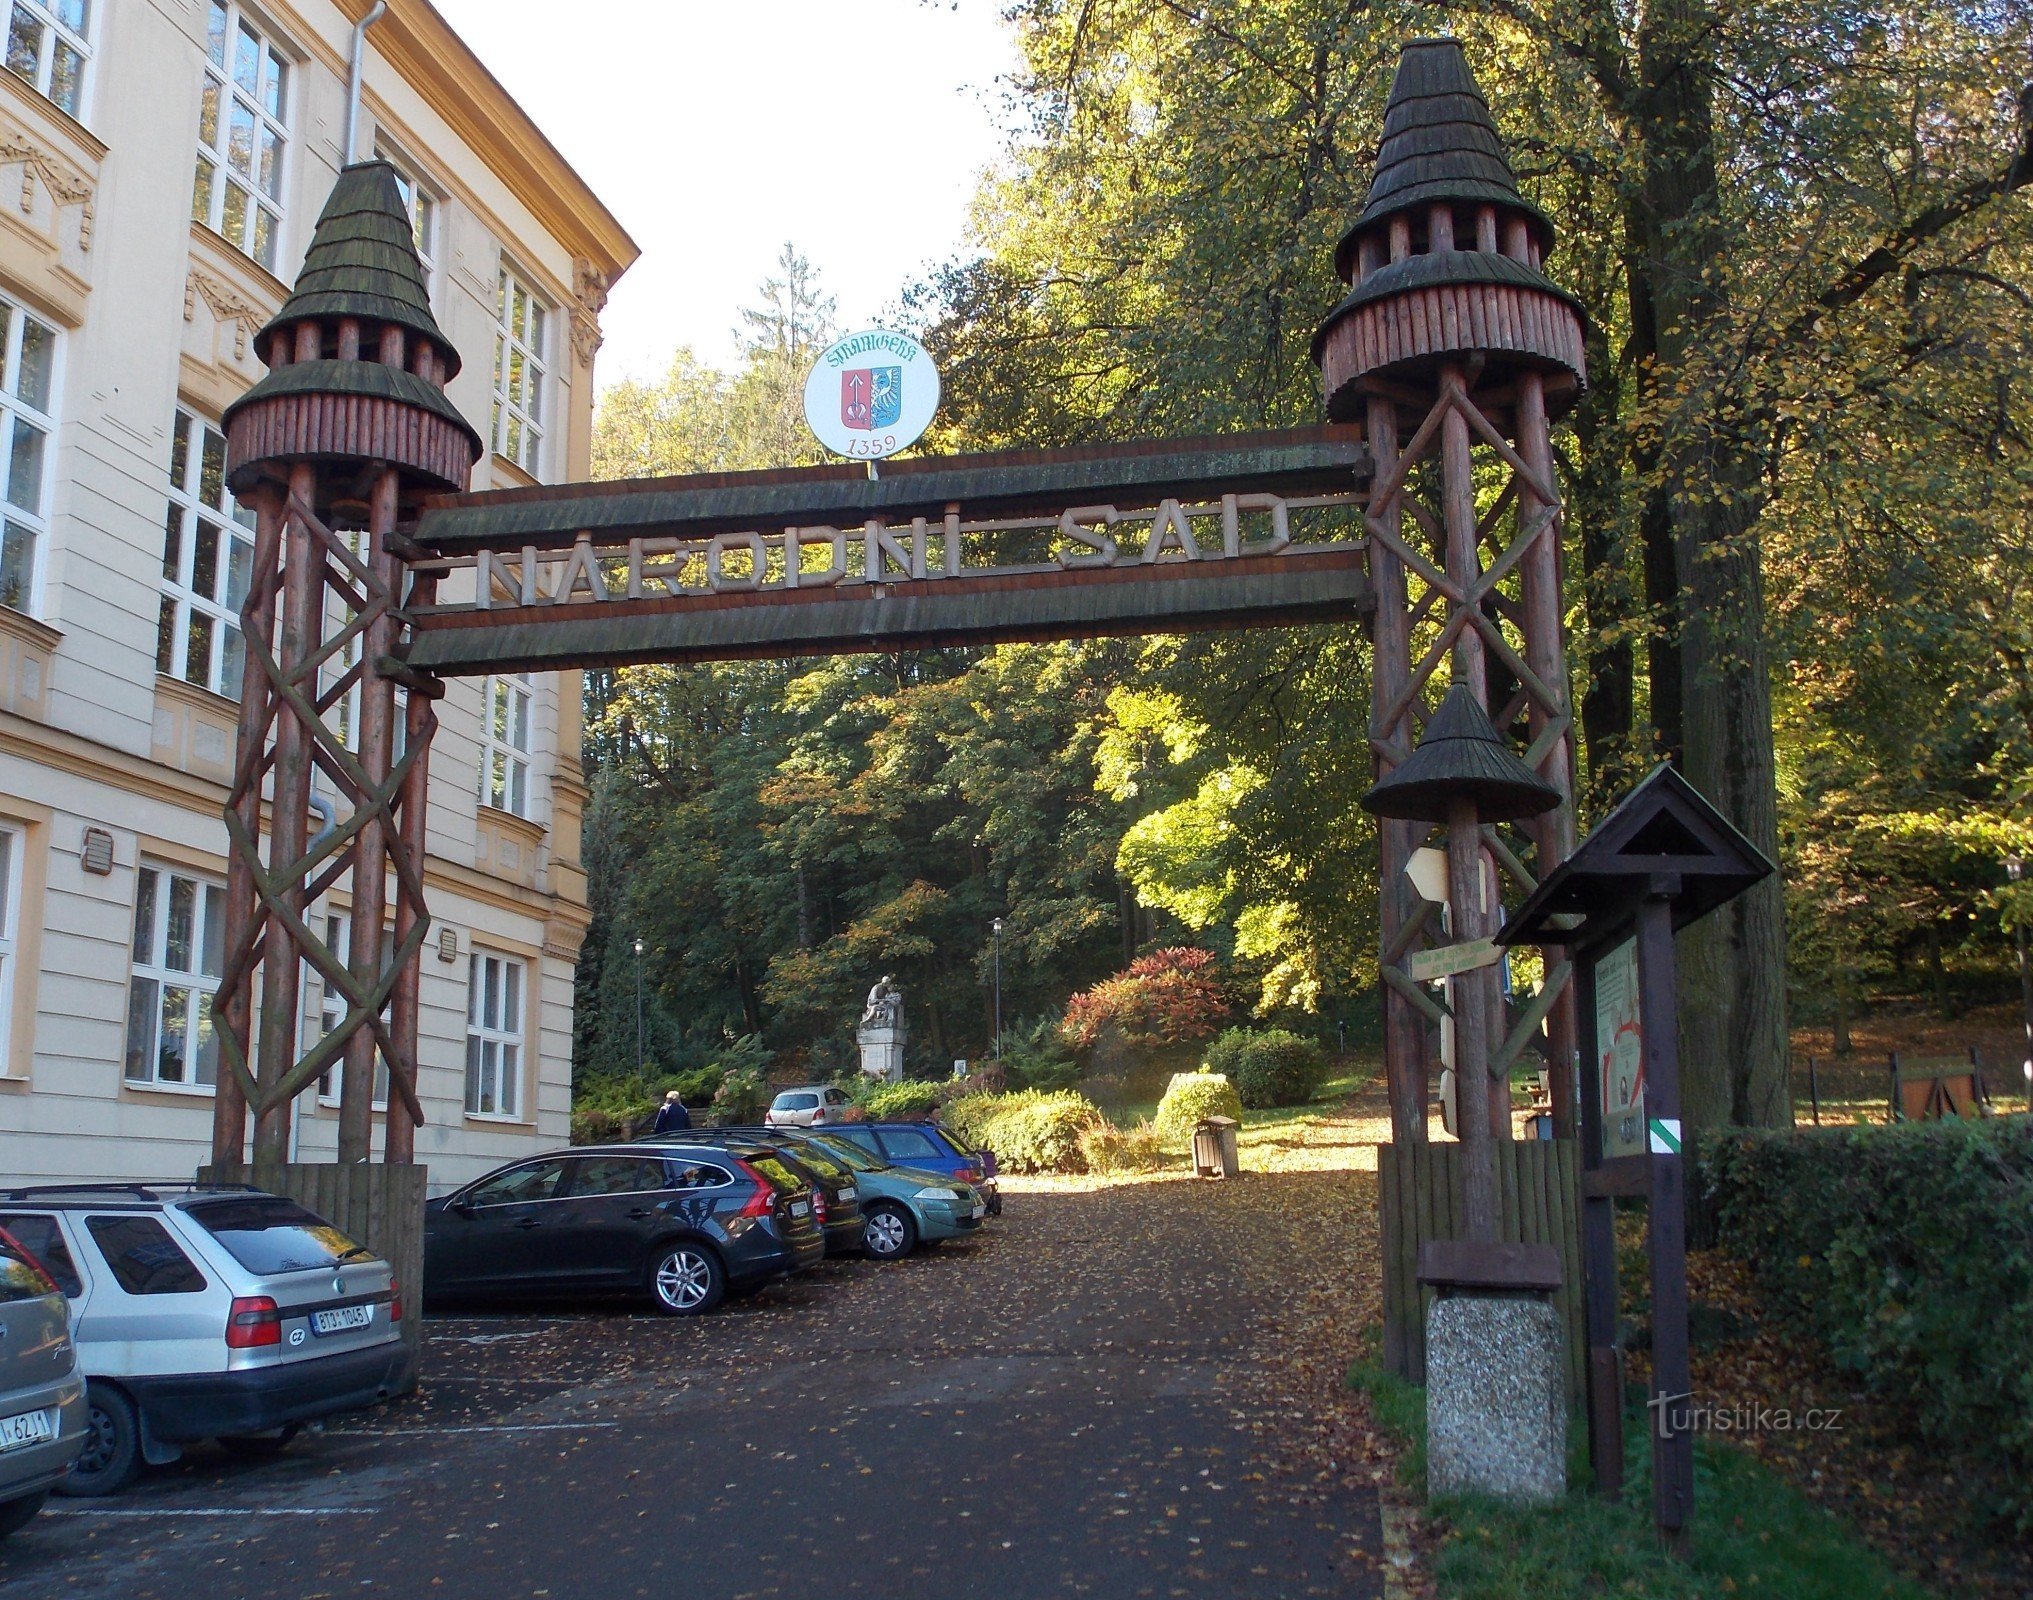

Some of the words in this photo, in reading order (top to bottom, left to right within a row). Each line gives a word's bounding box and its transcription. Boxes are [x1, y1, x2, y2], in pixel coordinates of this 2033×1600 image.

[845, 435, 897, 456] 1359
[1057, 493, 1290, 571] SAD
[342, 1307, 365, 1326] 1045
[292, 1331, 303, 1342] CZ
